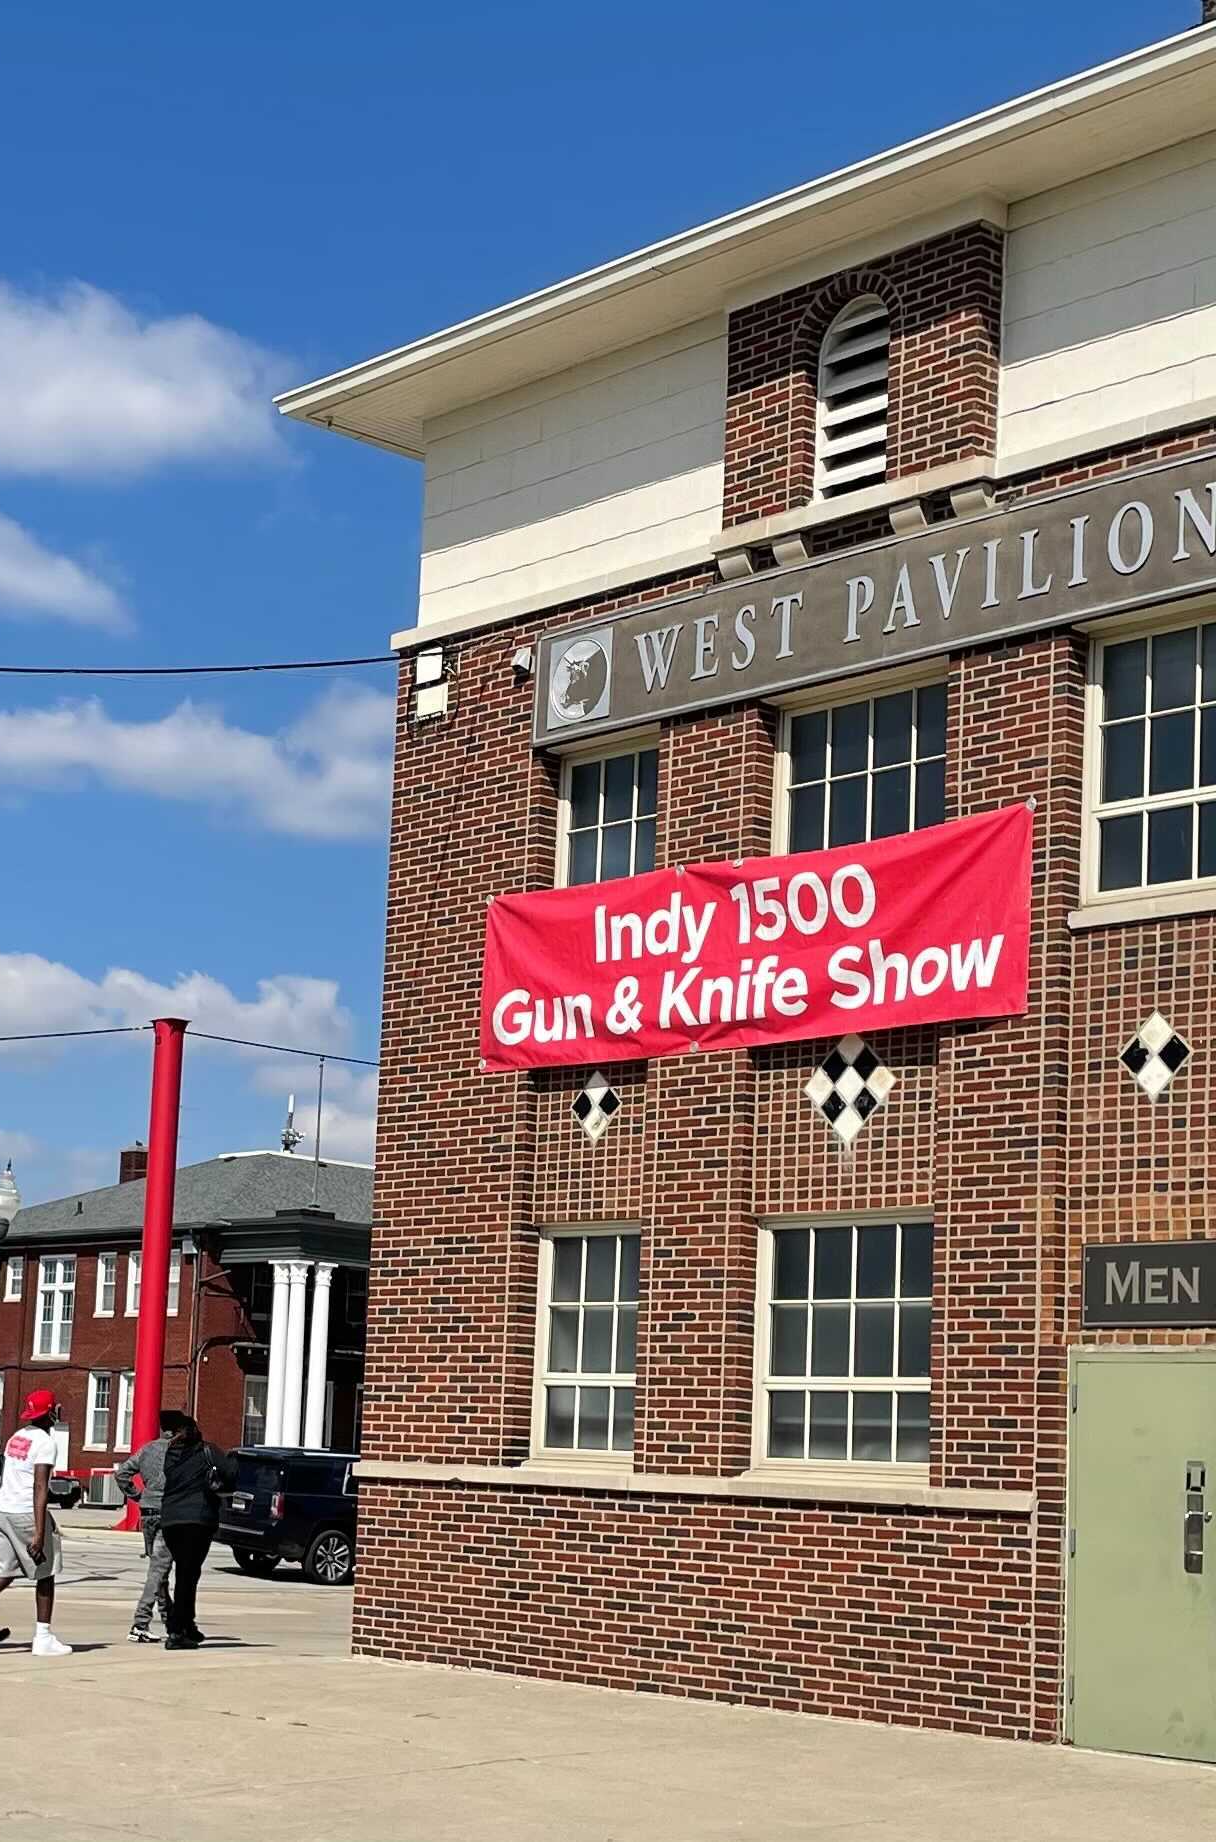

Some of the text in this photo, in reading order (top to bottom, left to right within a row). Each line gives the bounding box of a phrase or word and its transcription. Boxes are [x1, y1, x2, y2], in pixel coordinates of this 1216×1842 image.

[634, 481, 1216, 693] WEST PAVILION
[595, 864, 876, 964] Indy 1500
[492, 934, 1005, 1045] Gun & Knife Show
[1105, 1261, 1200, 1305] MEN
